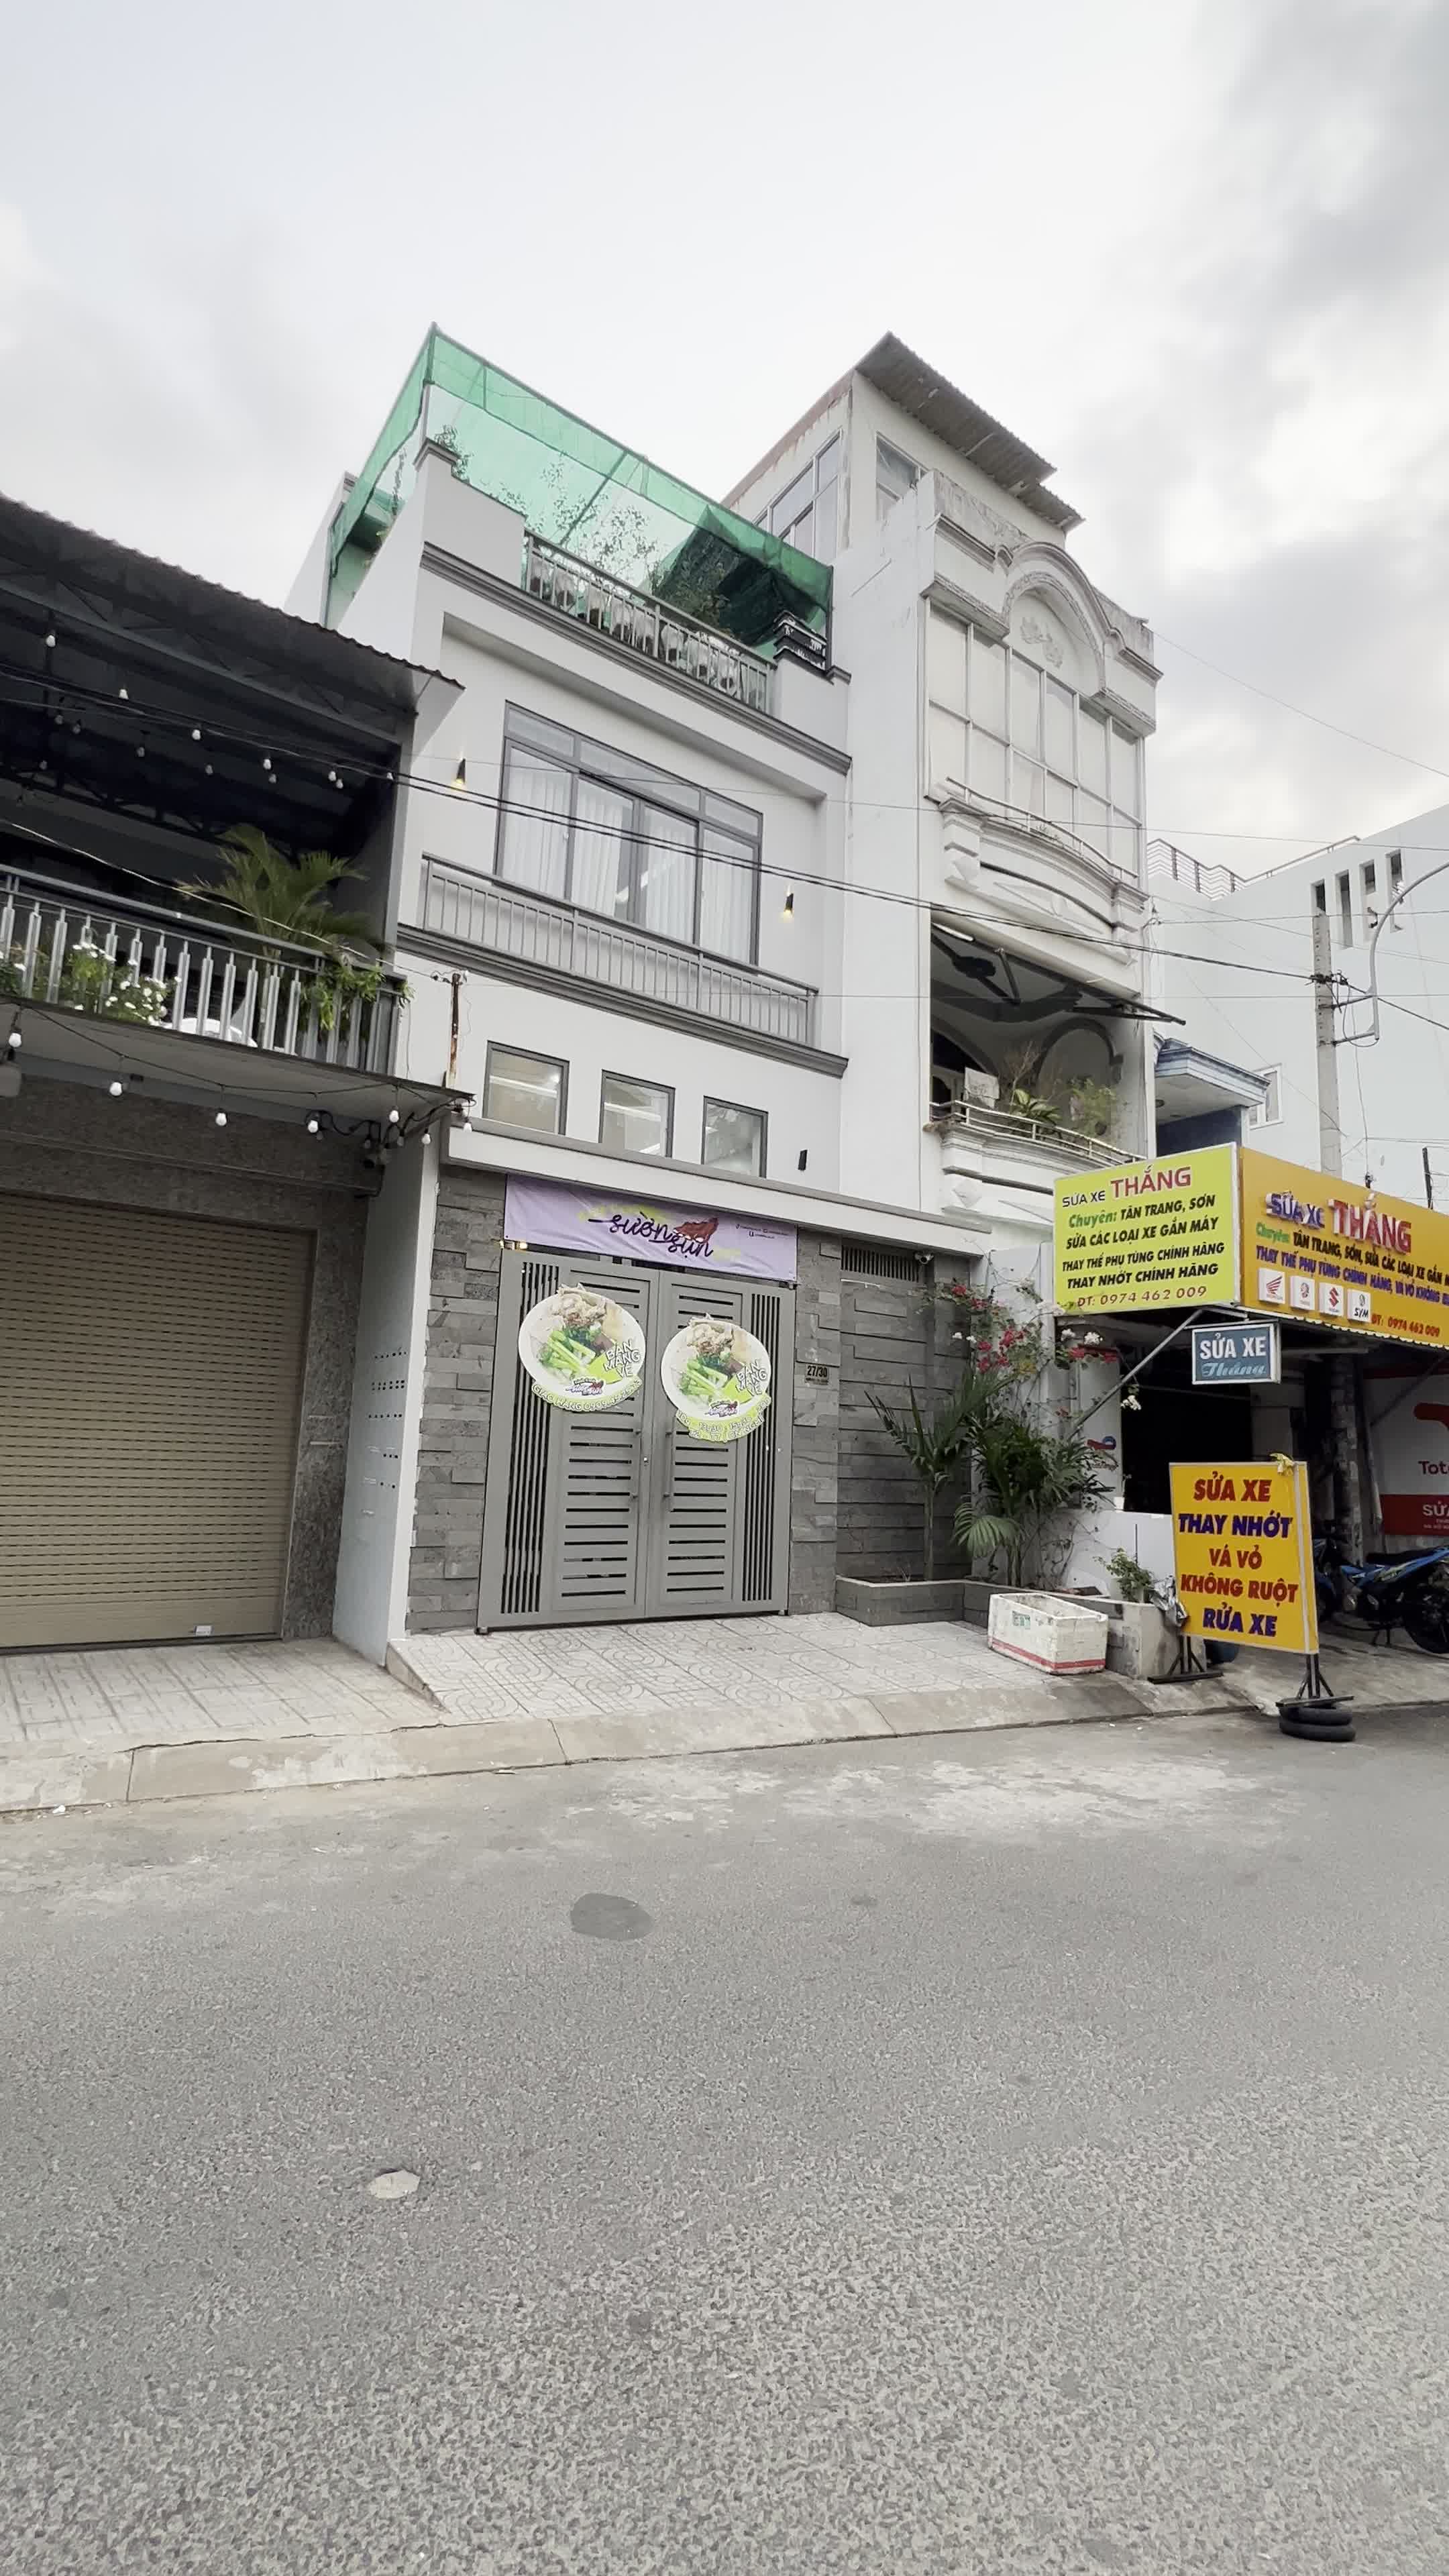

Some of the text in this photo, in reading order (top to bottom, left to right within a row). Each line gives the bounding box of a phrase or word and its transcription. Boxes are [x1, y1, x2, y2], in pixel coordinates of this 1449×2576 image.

[1090, 1190, 1106, 1203] XE
[1110, 1165, 1191, 1198] THẮNG
[1069, 1193, 1216, 1228] Chuyên: TÂN TRANG, SƠN
[1328, 1193, 1411, 1254] THẮNG
[1066, 1214, 1219, 1250] SỬA CÁC LOẠI XE GẮN MÁY
[663, 1237, 714, 1258] sụn
[1062, 1258, 1085, 1271] THAY
[1087, 1252, 1104, 1269] THẾ
[1105, 1254, 1125, 1269] PHỤ
[1127, 1250, 1154, 1265] TÙNG
[1157, 1245, 1189, 1260] CHÍNH
[1256, 1244, 1279, 1264] THAY
[1281, 1250, 1299, 1269] THẾ
[1299, 1256, 1316, 1277] PHỤ
[1293, 1229, 1310, 1249] TÂN
[1311, 1236, 1342, 1260] TRANG,
[1381, 1254, 1395, 1271] CÁC
[1397, 1260, 1415, 1278] LOẠI
[1415, 1265, 1426, 1280] XE
[1427, 1264, 1442, 1284] GẮN
[1067, 1275, 1096, 1289] THAY
[1097, 1270, 1133, 1286] NHỚT
[1135, 1267, 1175, 1282] CHÍNH
[1077, 1286, 1208, 1307] ĐT: 0974 462 009
[1354, 1307, 1369, 1318] SYM
[1387, 1316, 1407, 1331] 0974
[1409, 1321, 1424, 1334] 462
[1425, 1325, 1440, 1338] 009
[1200, 1332, 1267, 1360] SỬA XE
[1193, 1471, 1273, 1502] SỬA XE
[1178, 1509, 1293, 1538] THAY NHỚT
[1209, 1544, 1263, 1569] VÁ VỎ
[1181, 1572, 1299, 1607] KHÔNG RUỘT
[1202, 1602, 1278, 1637] RỬA XE
